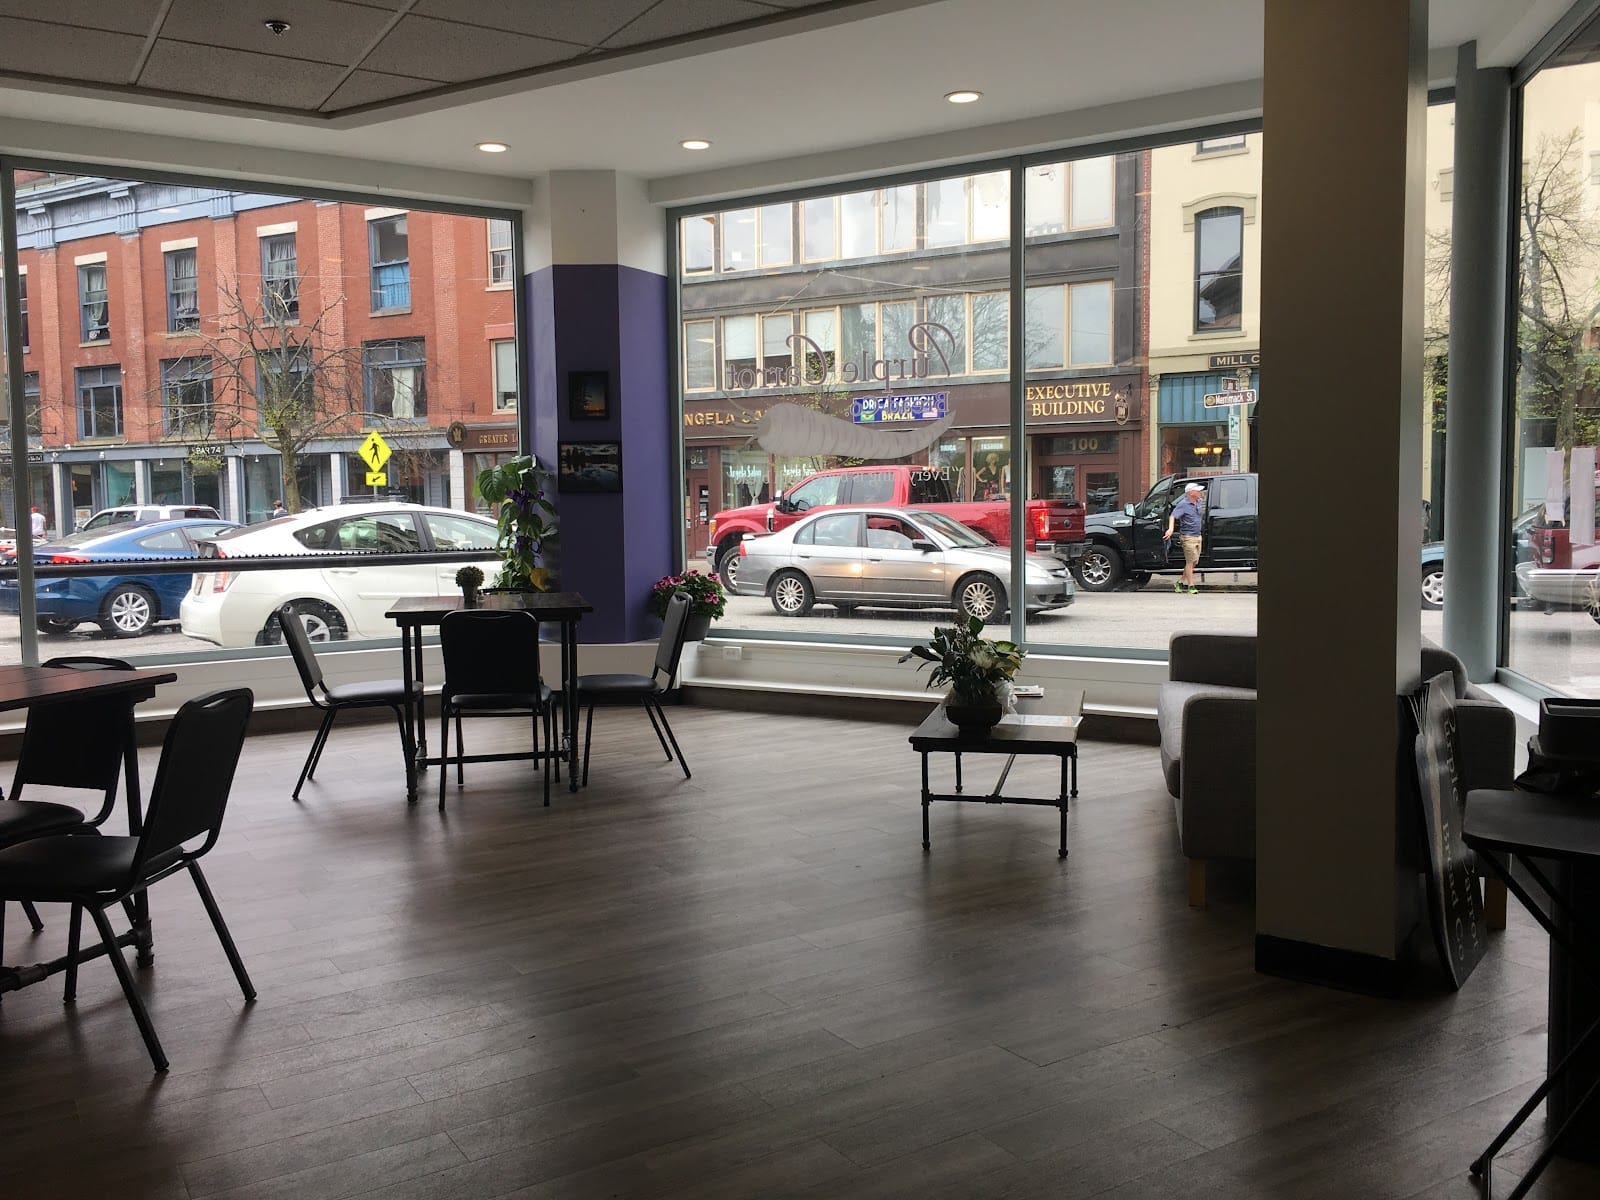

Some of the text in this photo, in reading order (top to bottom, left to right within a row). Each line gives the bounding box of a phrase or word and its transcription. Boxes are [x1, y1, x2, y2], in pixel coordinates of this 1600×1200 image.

[1216, 355, 1247, 366] MILL
[1026, 382, 1111, 400] EXECUTIVE
[1215, 392, 1253, 405] Merrimack St
[1032, 400, 1105, 417] BUILDING
[684, 412, 736, 426] NGELA
[881, 411, 915, 421] BRAZIL
[211, 446, 221, 454] 74
[1070, 438, 1098, 451] 100
